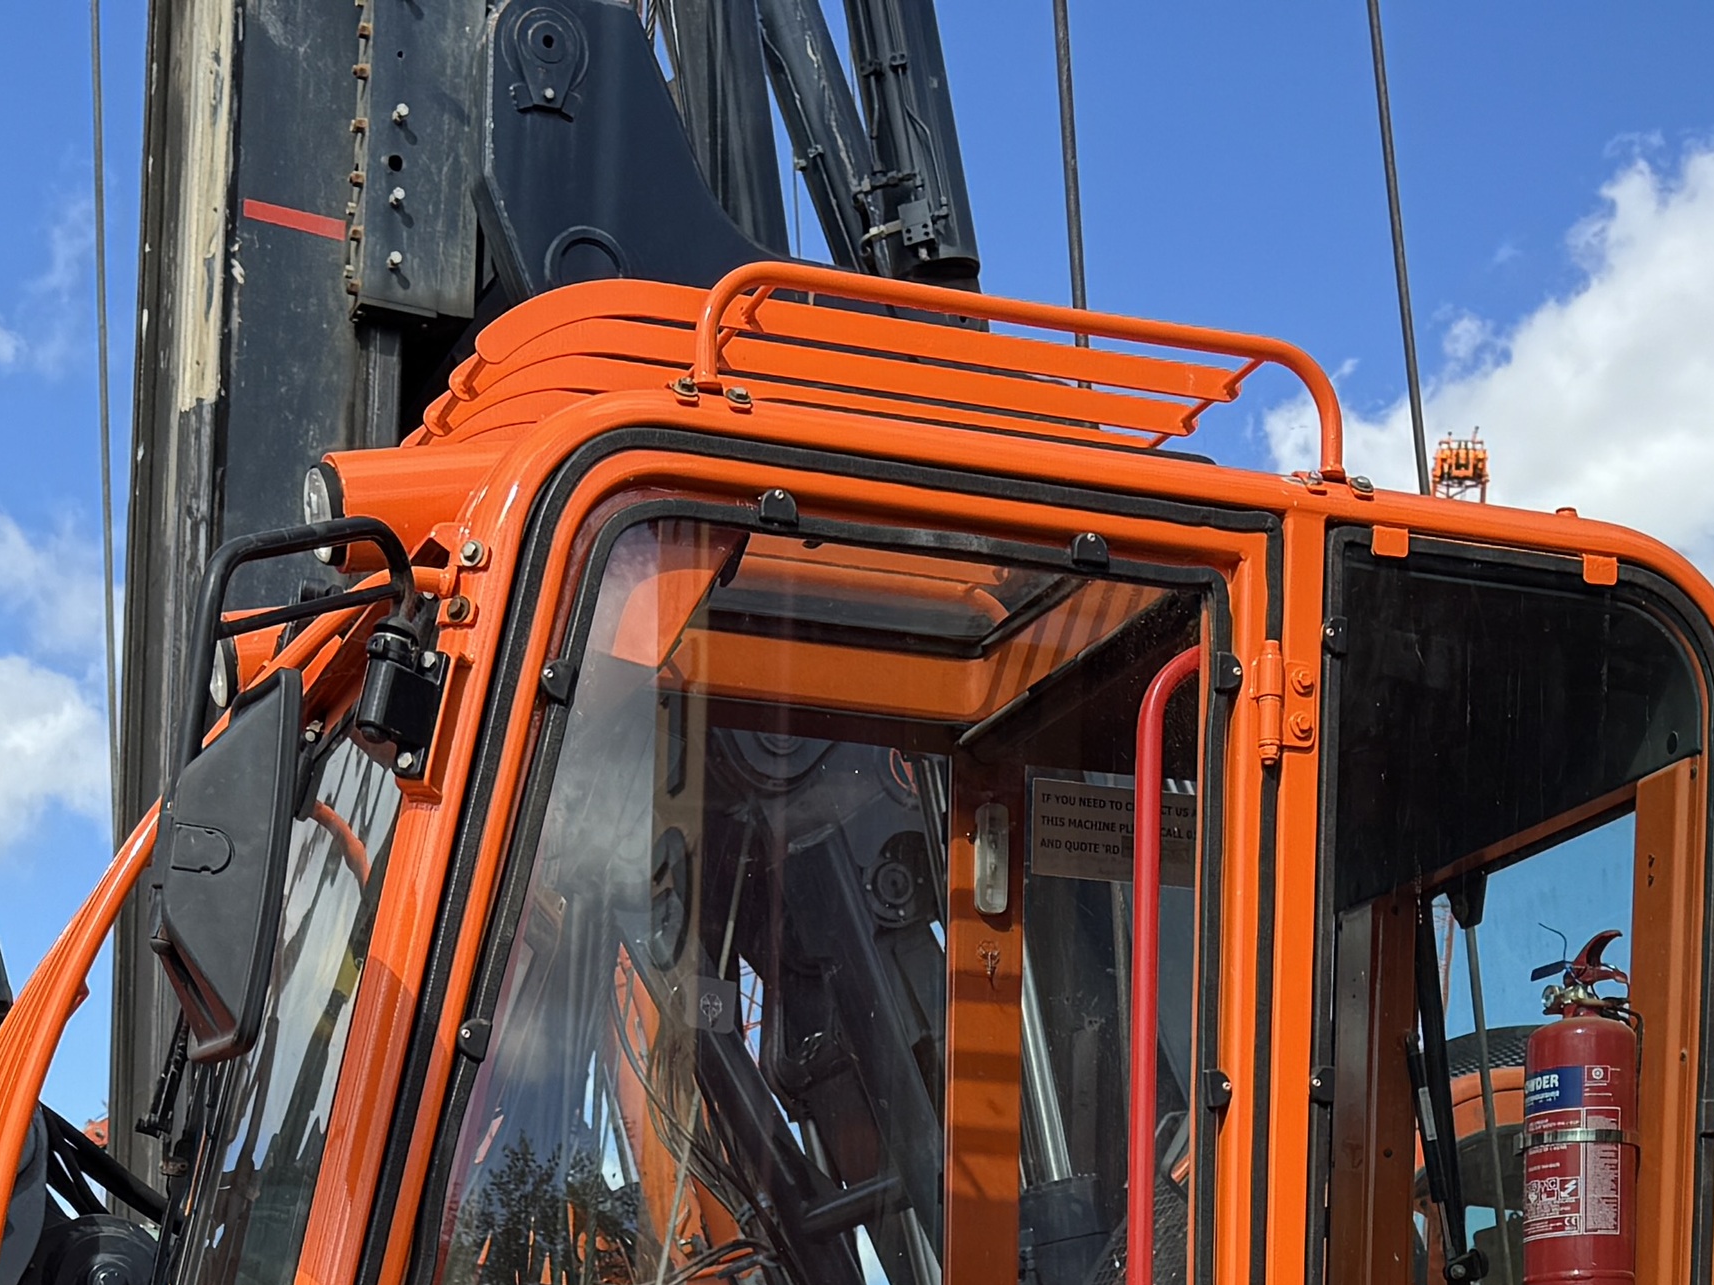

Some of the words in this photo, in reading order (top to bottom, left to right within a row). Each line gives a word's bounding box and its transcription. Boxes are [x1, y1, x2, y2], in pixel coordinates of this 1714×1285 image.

[1041, 792, 1051, 804] IF
[1054, 794, 1076, 806] YOU
[1078, 796, 1106, 809] NEED
[1108, 799, 1123, 811] TO
[1175, 805, 1189, 818] US
[1040, 815, 1065, 827] THIS
[1068, 818, 1117, 833] MACHINE
[1040, 838, 1062, 850] AND
[1064, 839, 1100, 853] QUOTE
